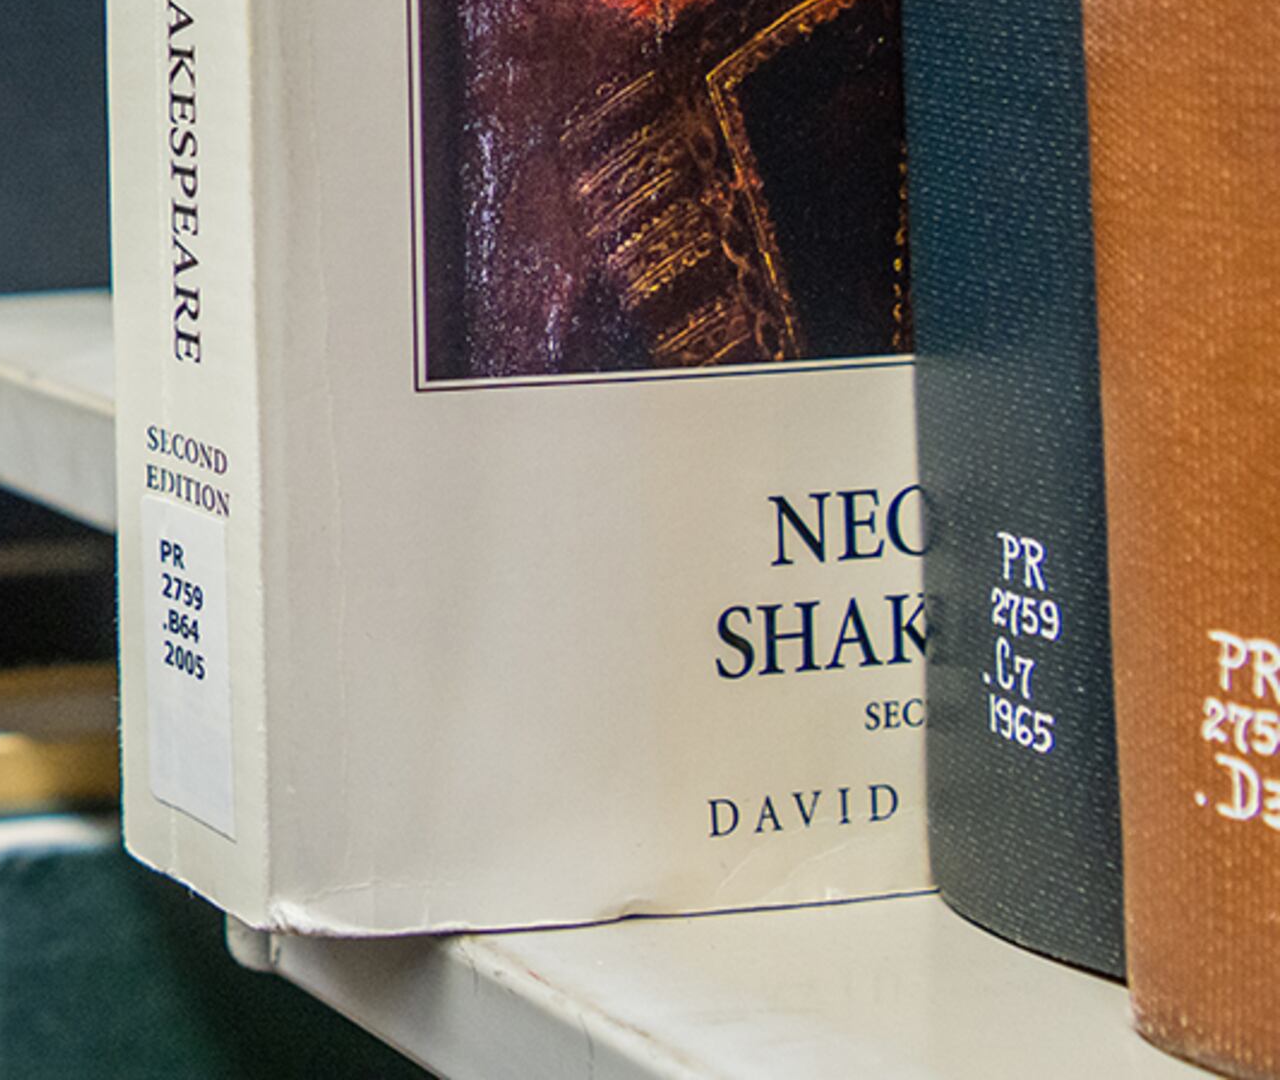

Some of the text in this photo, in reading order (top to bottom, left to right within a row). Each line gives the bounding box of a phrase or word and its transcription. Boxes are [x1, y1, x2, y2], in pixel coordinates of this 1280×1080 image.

[146, 424, 229, 476] SECOND
[145, 463, 230, 518] EDITION
[159, 539, 185, 571] PR
[997, 531, 1047, 592] PR
[161, 573, 204, 612] 2759
[991, 587, 1061, 641] 2759
[162, 609, 200, 644] .B64
[164, 640, 206, 681] 2005
[981, 635, 1035, 701] .C7
[1207, 630, 1280, 704] PR
[989, 693, 1055, 754] 1965
[708, 784, 900, 838] DAVID
